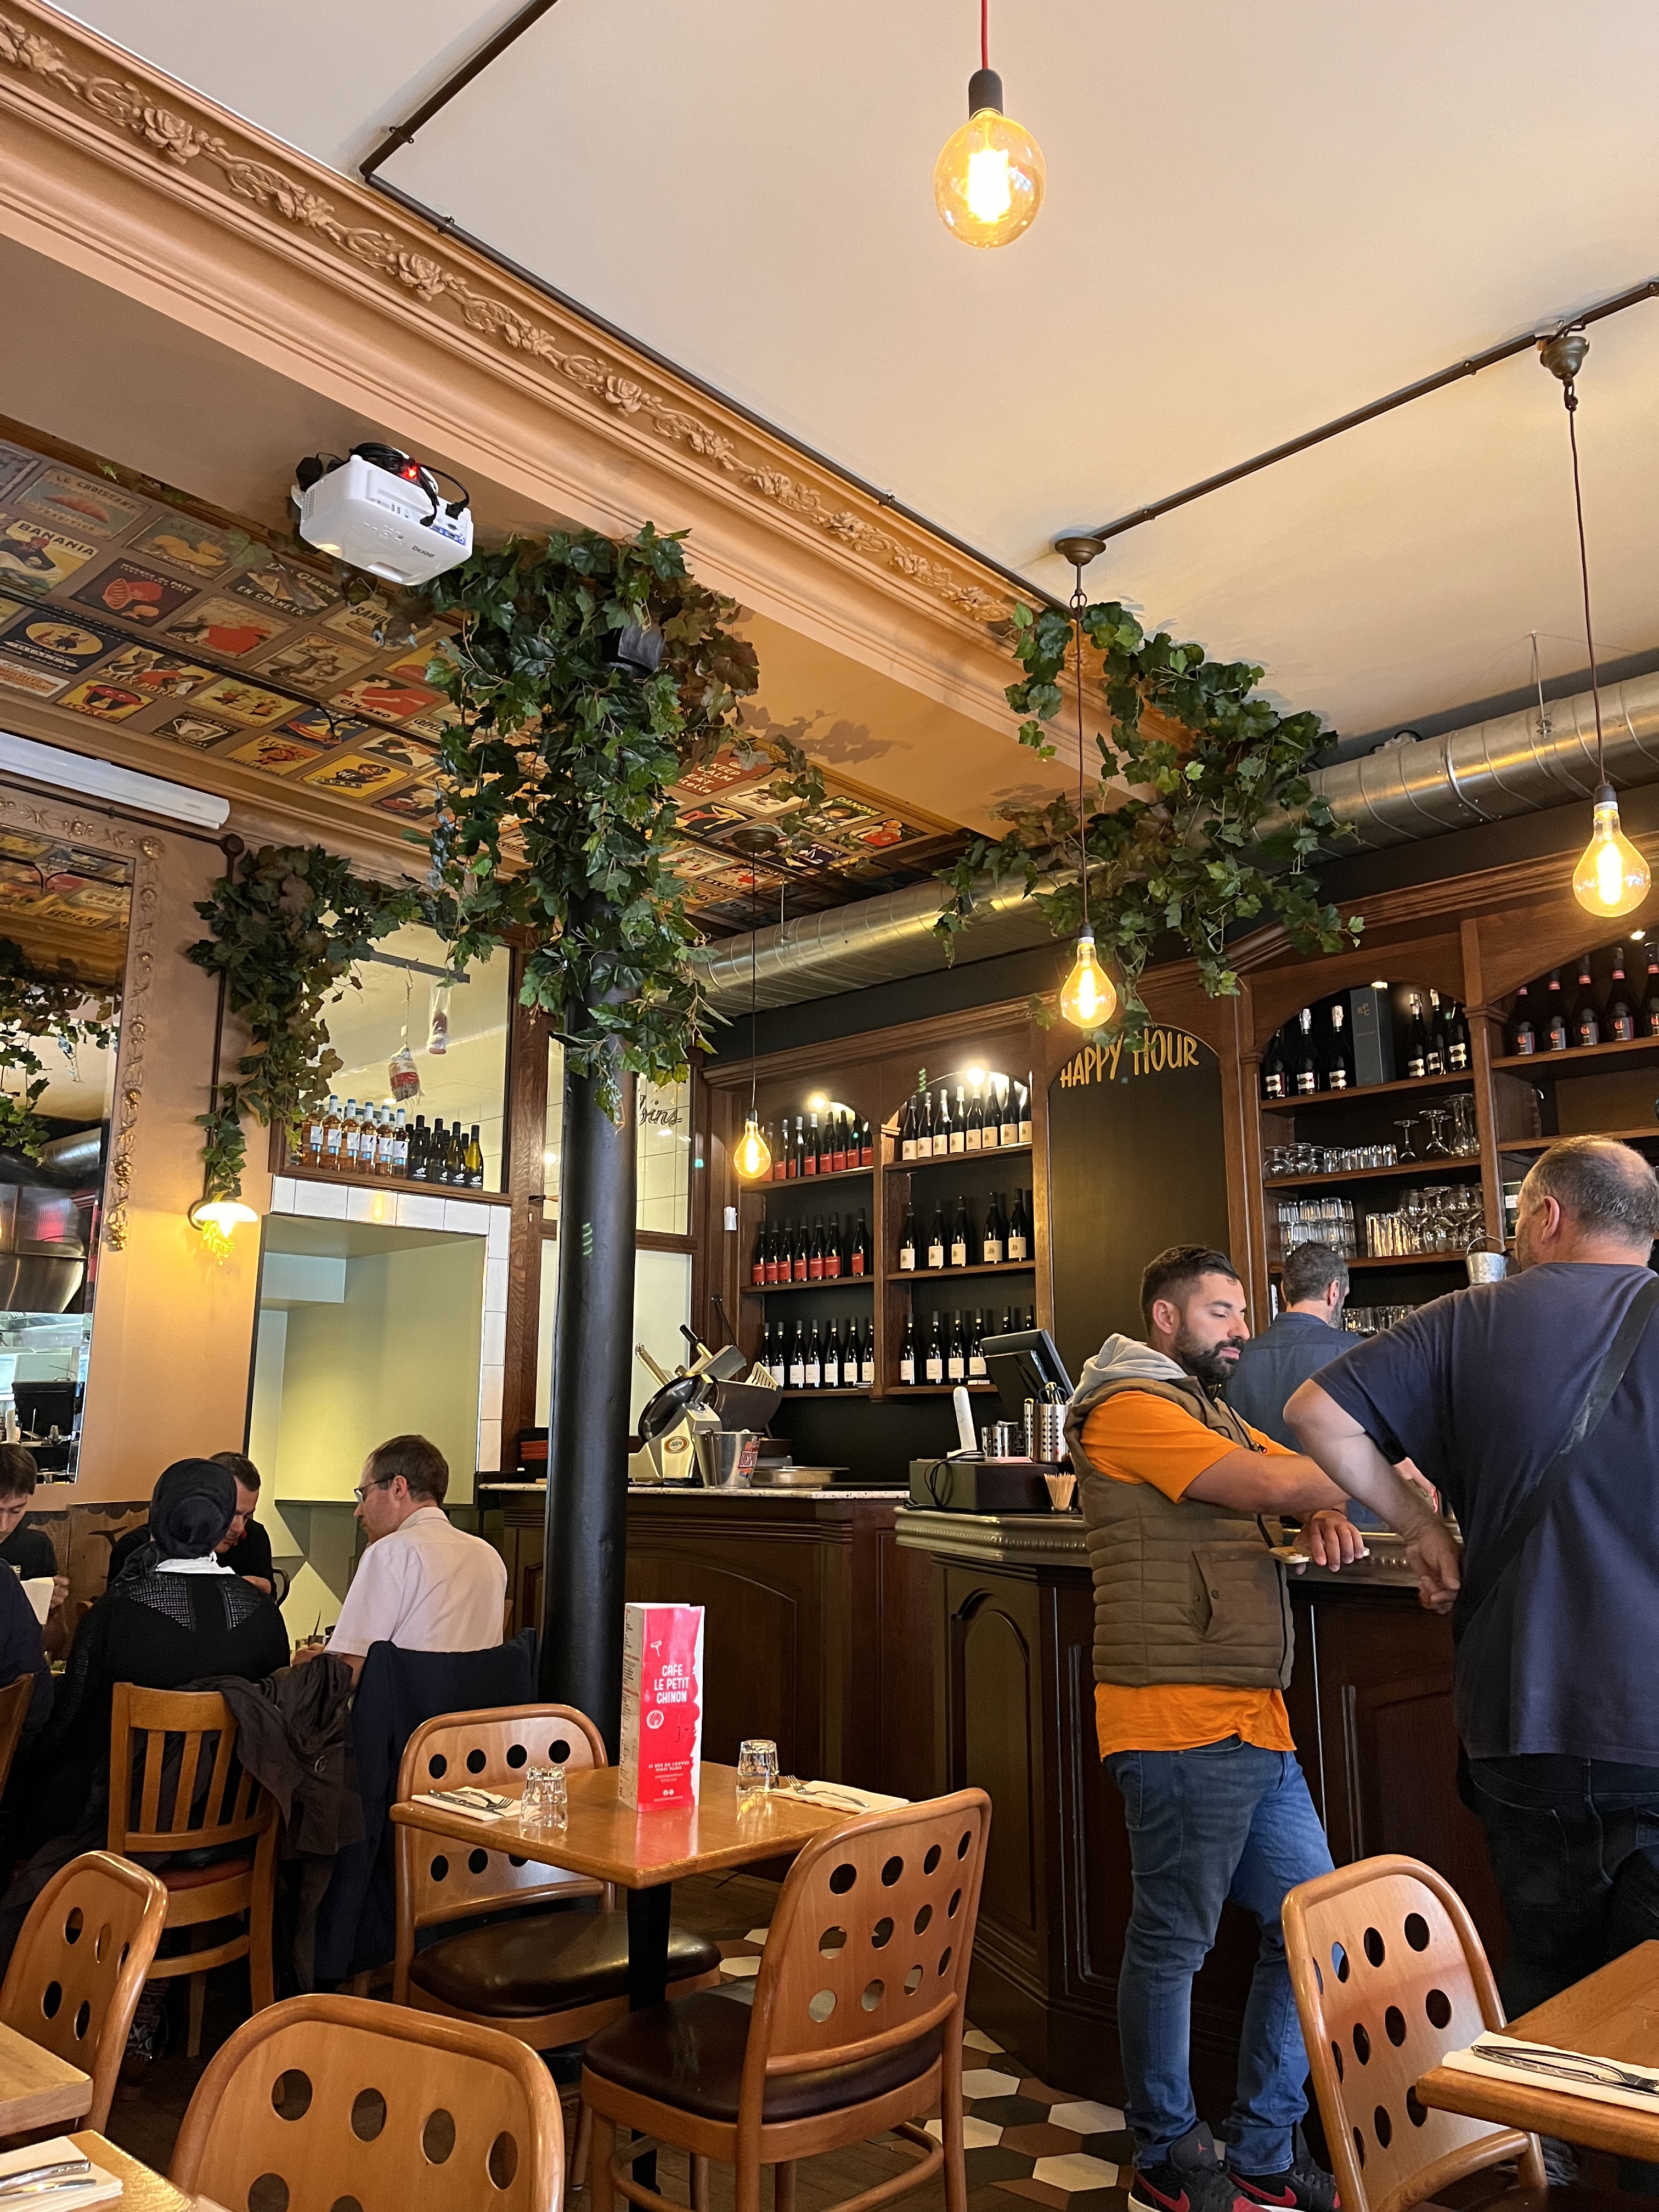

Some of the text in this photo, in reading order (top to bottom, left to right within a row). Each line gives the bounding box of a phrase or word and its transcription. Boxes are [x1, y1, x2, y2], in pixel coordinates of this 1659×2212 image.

[77, 481, 136, 510] CROISSANT
[18, 523, 94, 556] BANANIA
[171, 582, 193, 591] PAIN
[297, 572, 340, 597] Glaces
[237, 586, 254, 594] EN
[255, 593, 305, 615] CORNETS
[350, 607, 388, 622] SAND
[340, 699, 391, 718] CINANO
[697, 764, 733, 782] CALM
[709, 763, 741, 775] KEEP
[686, 774, 714, 785] EAT
[836, 797, 882, 816] DANONE
[1060, 1028, 1199, 1088] HAPPY HOUR
[662, 1664, 683, 1677] CAFE
[654, 1677, 690, 1691] LE PETIT
[657, 1690, 687, 1704] CHINON
